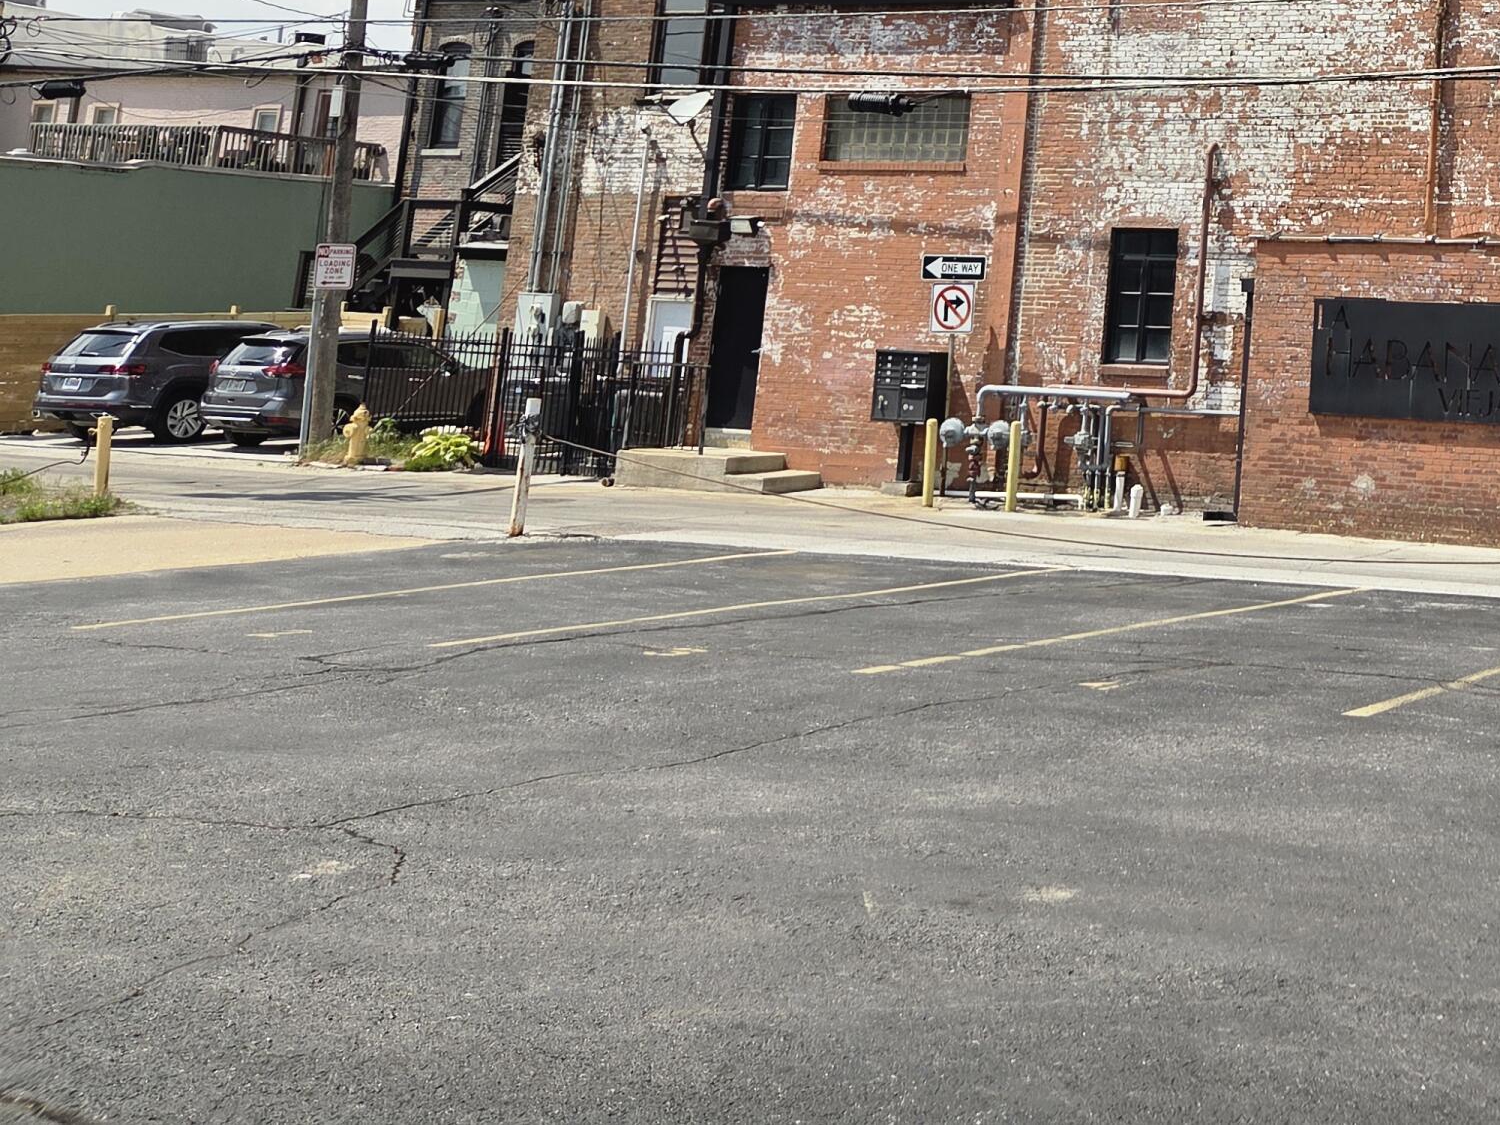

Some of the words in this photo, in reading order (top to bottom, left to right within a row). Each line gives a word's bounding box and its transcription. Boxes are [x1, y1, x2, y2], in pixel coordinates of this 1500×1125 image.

[318, 247, 329, 256] NO
[941, 263, 958, 272] ONE
[962, 263, 979, 273] WAY
